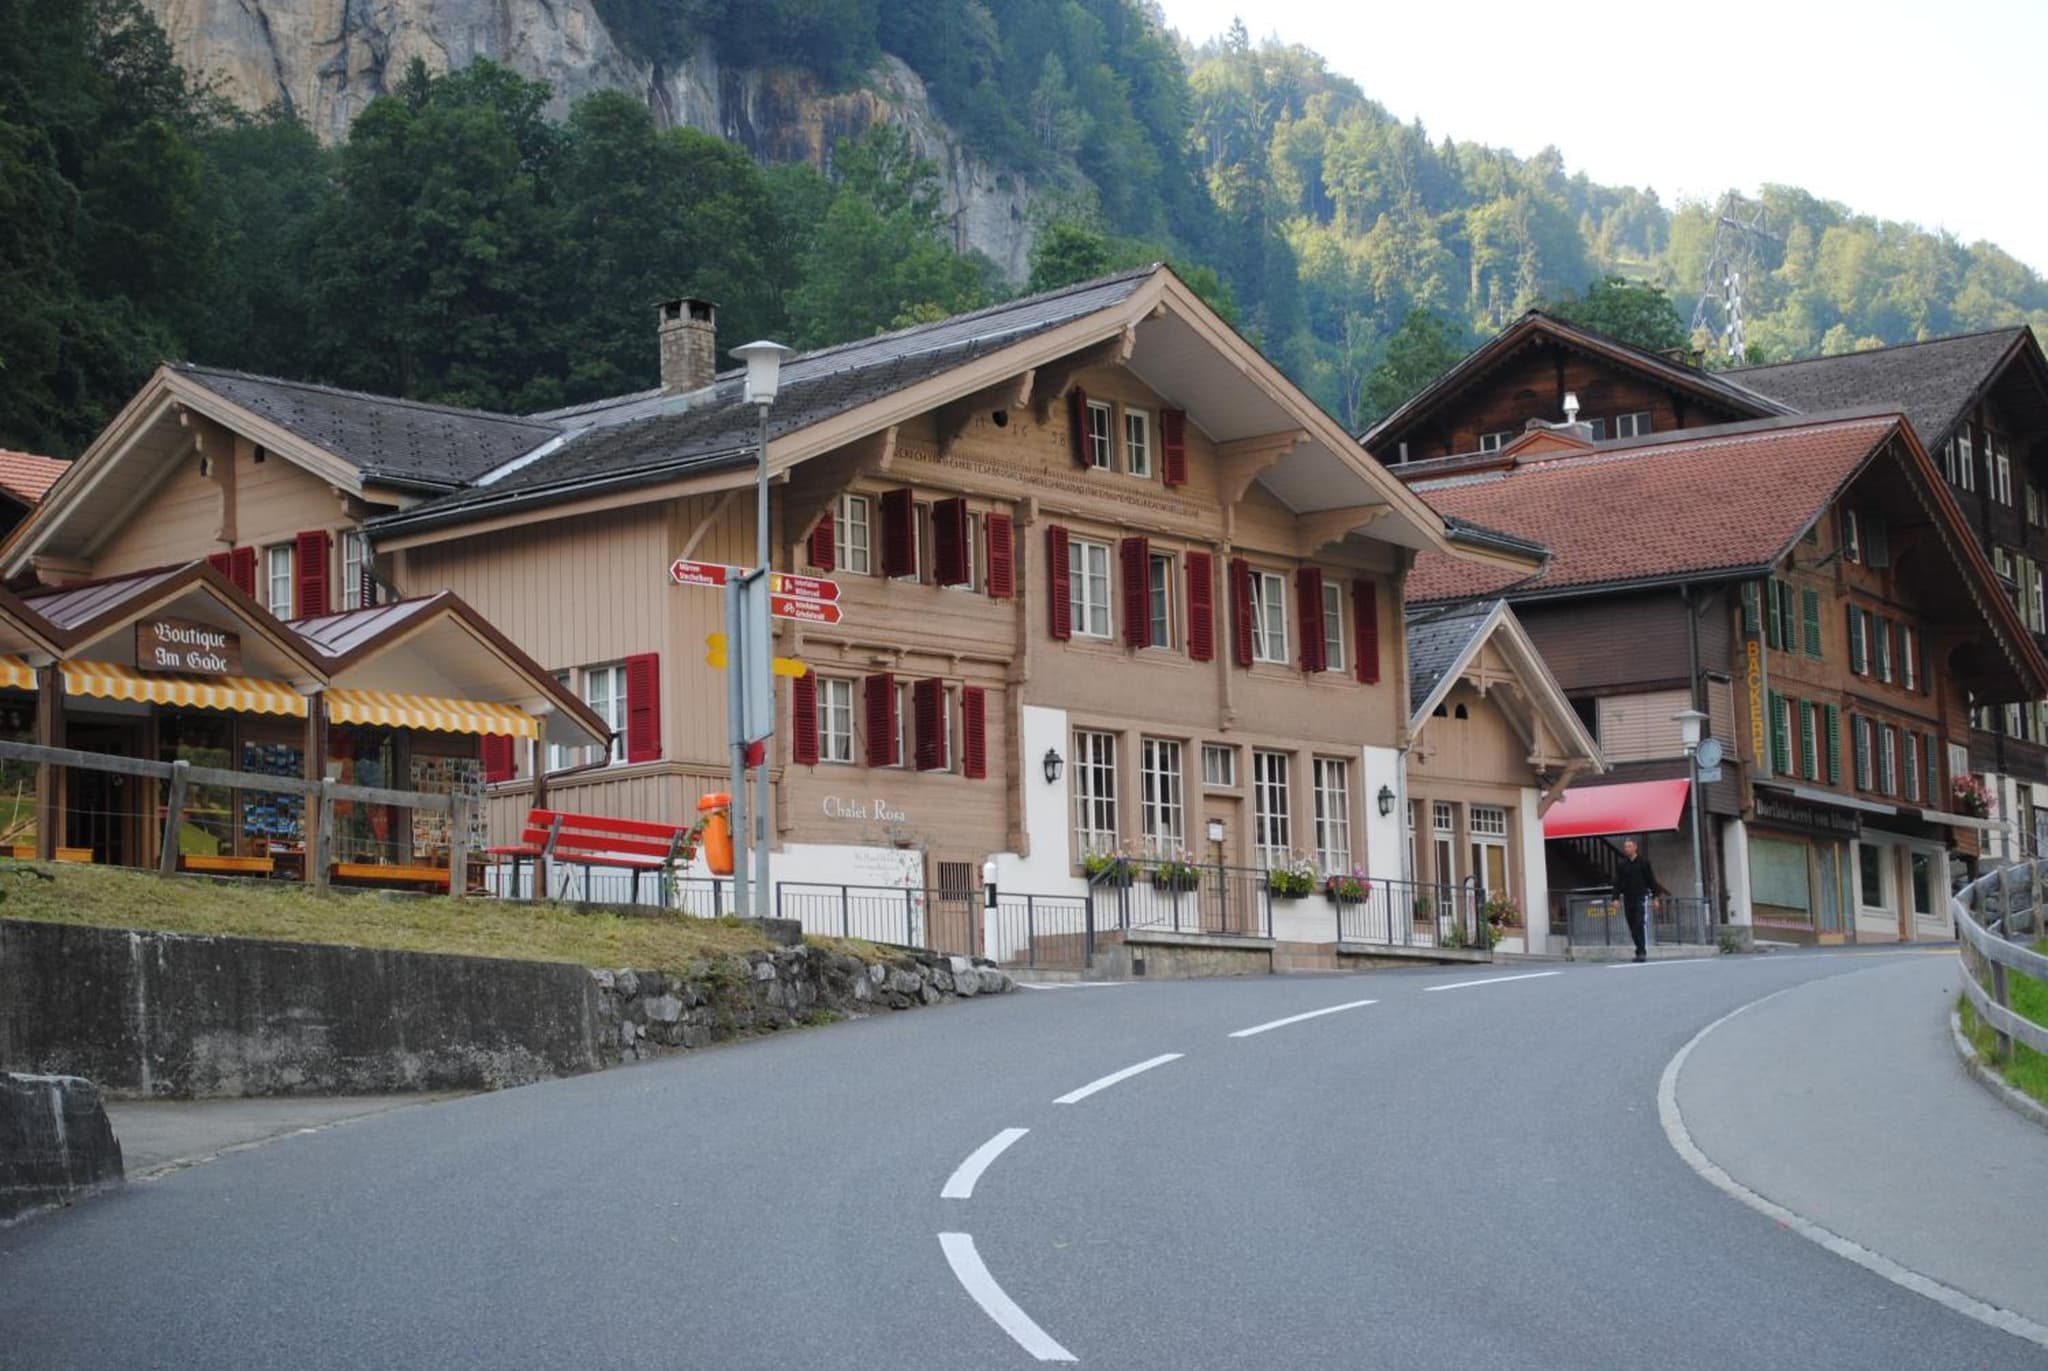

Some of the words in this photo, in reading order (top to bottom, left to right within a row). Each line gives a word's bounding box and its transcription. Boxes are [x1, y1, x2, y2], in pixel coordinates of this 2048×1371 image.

[154, 622, 226, 652] Boutique
[155, 647, 180, 667] Im
[186, 651, 227, 672] Gade
[823, 795, 868, 819] Chalet
[873, 799, 905, 822] Rosa
